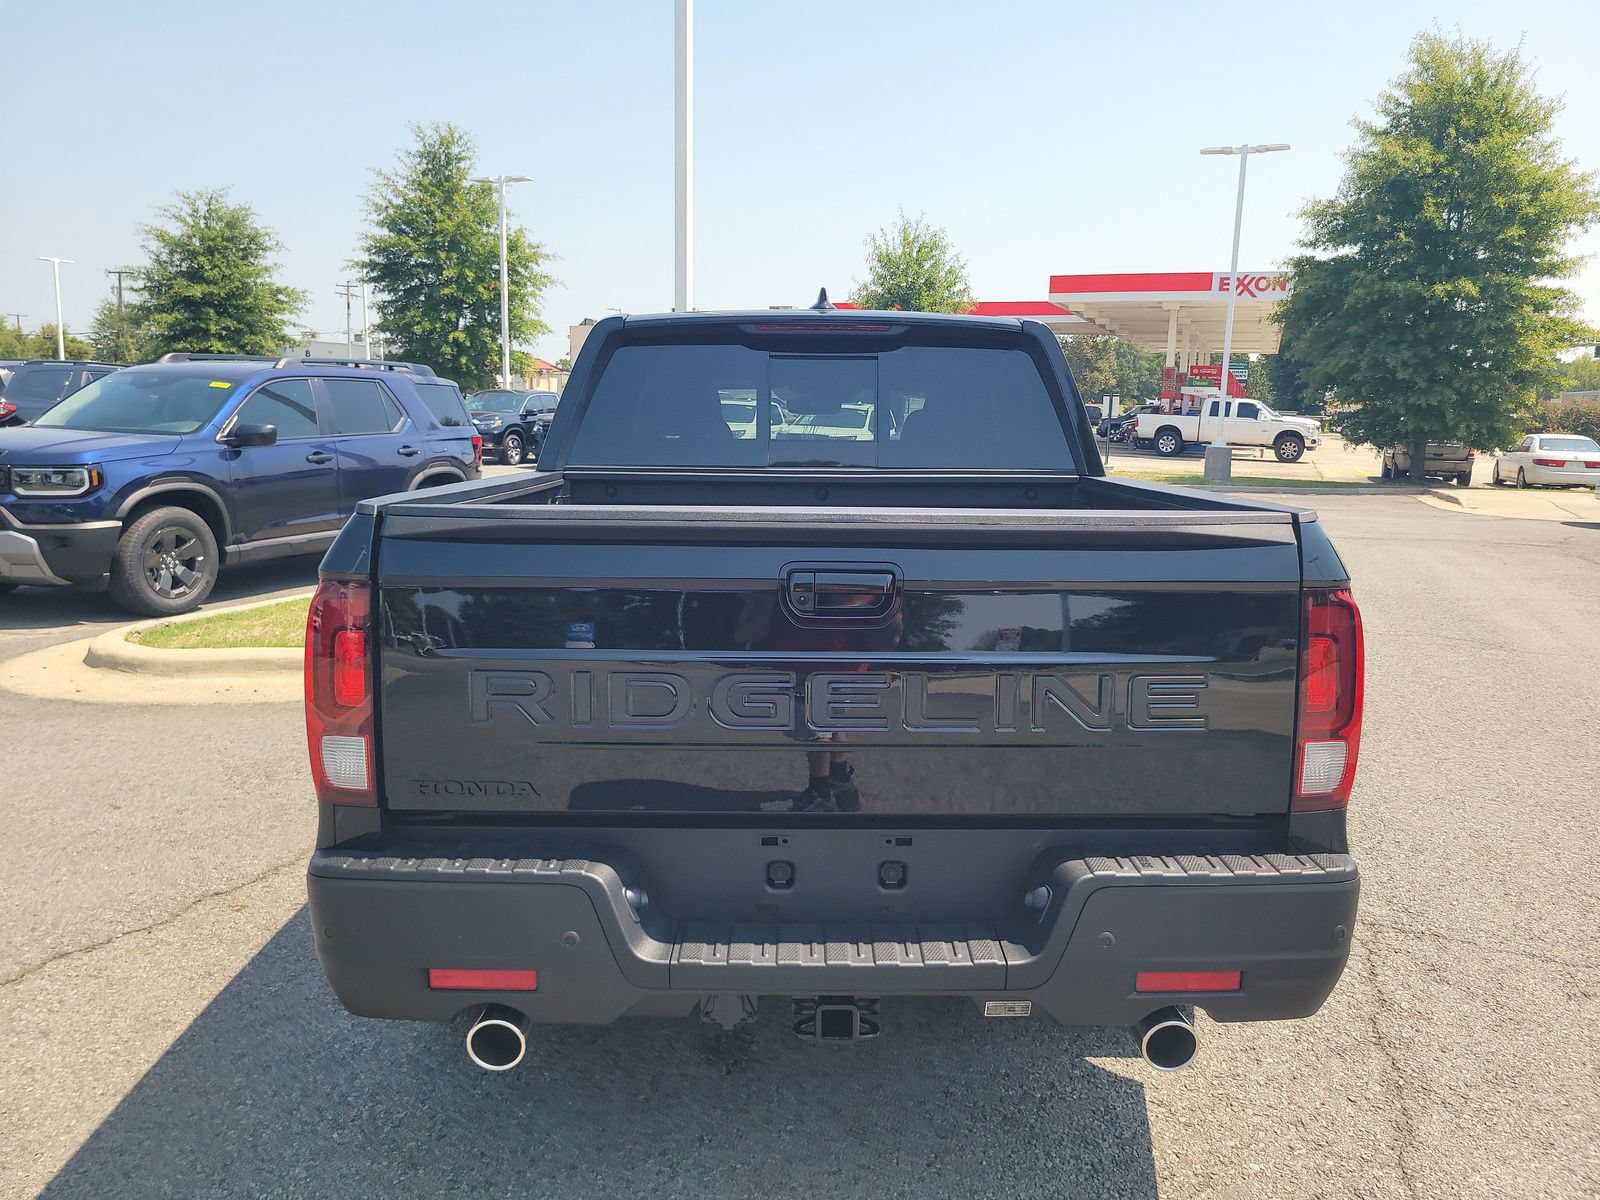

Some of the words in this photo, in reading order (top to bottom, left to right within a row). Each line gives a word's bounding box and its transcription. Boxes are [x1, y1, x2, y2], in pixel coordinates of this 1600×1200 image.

[1219, 274, 1287, 298] EXXON
[468, 668, 1209, 733] RIDGELINE
[412, 779, 541, 797] HONDA
